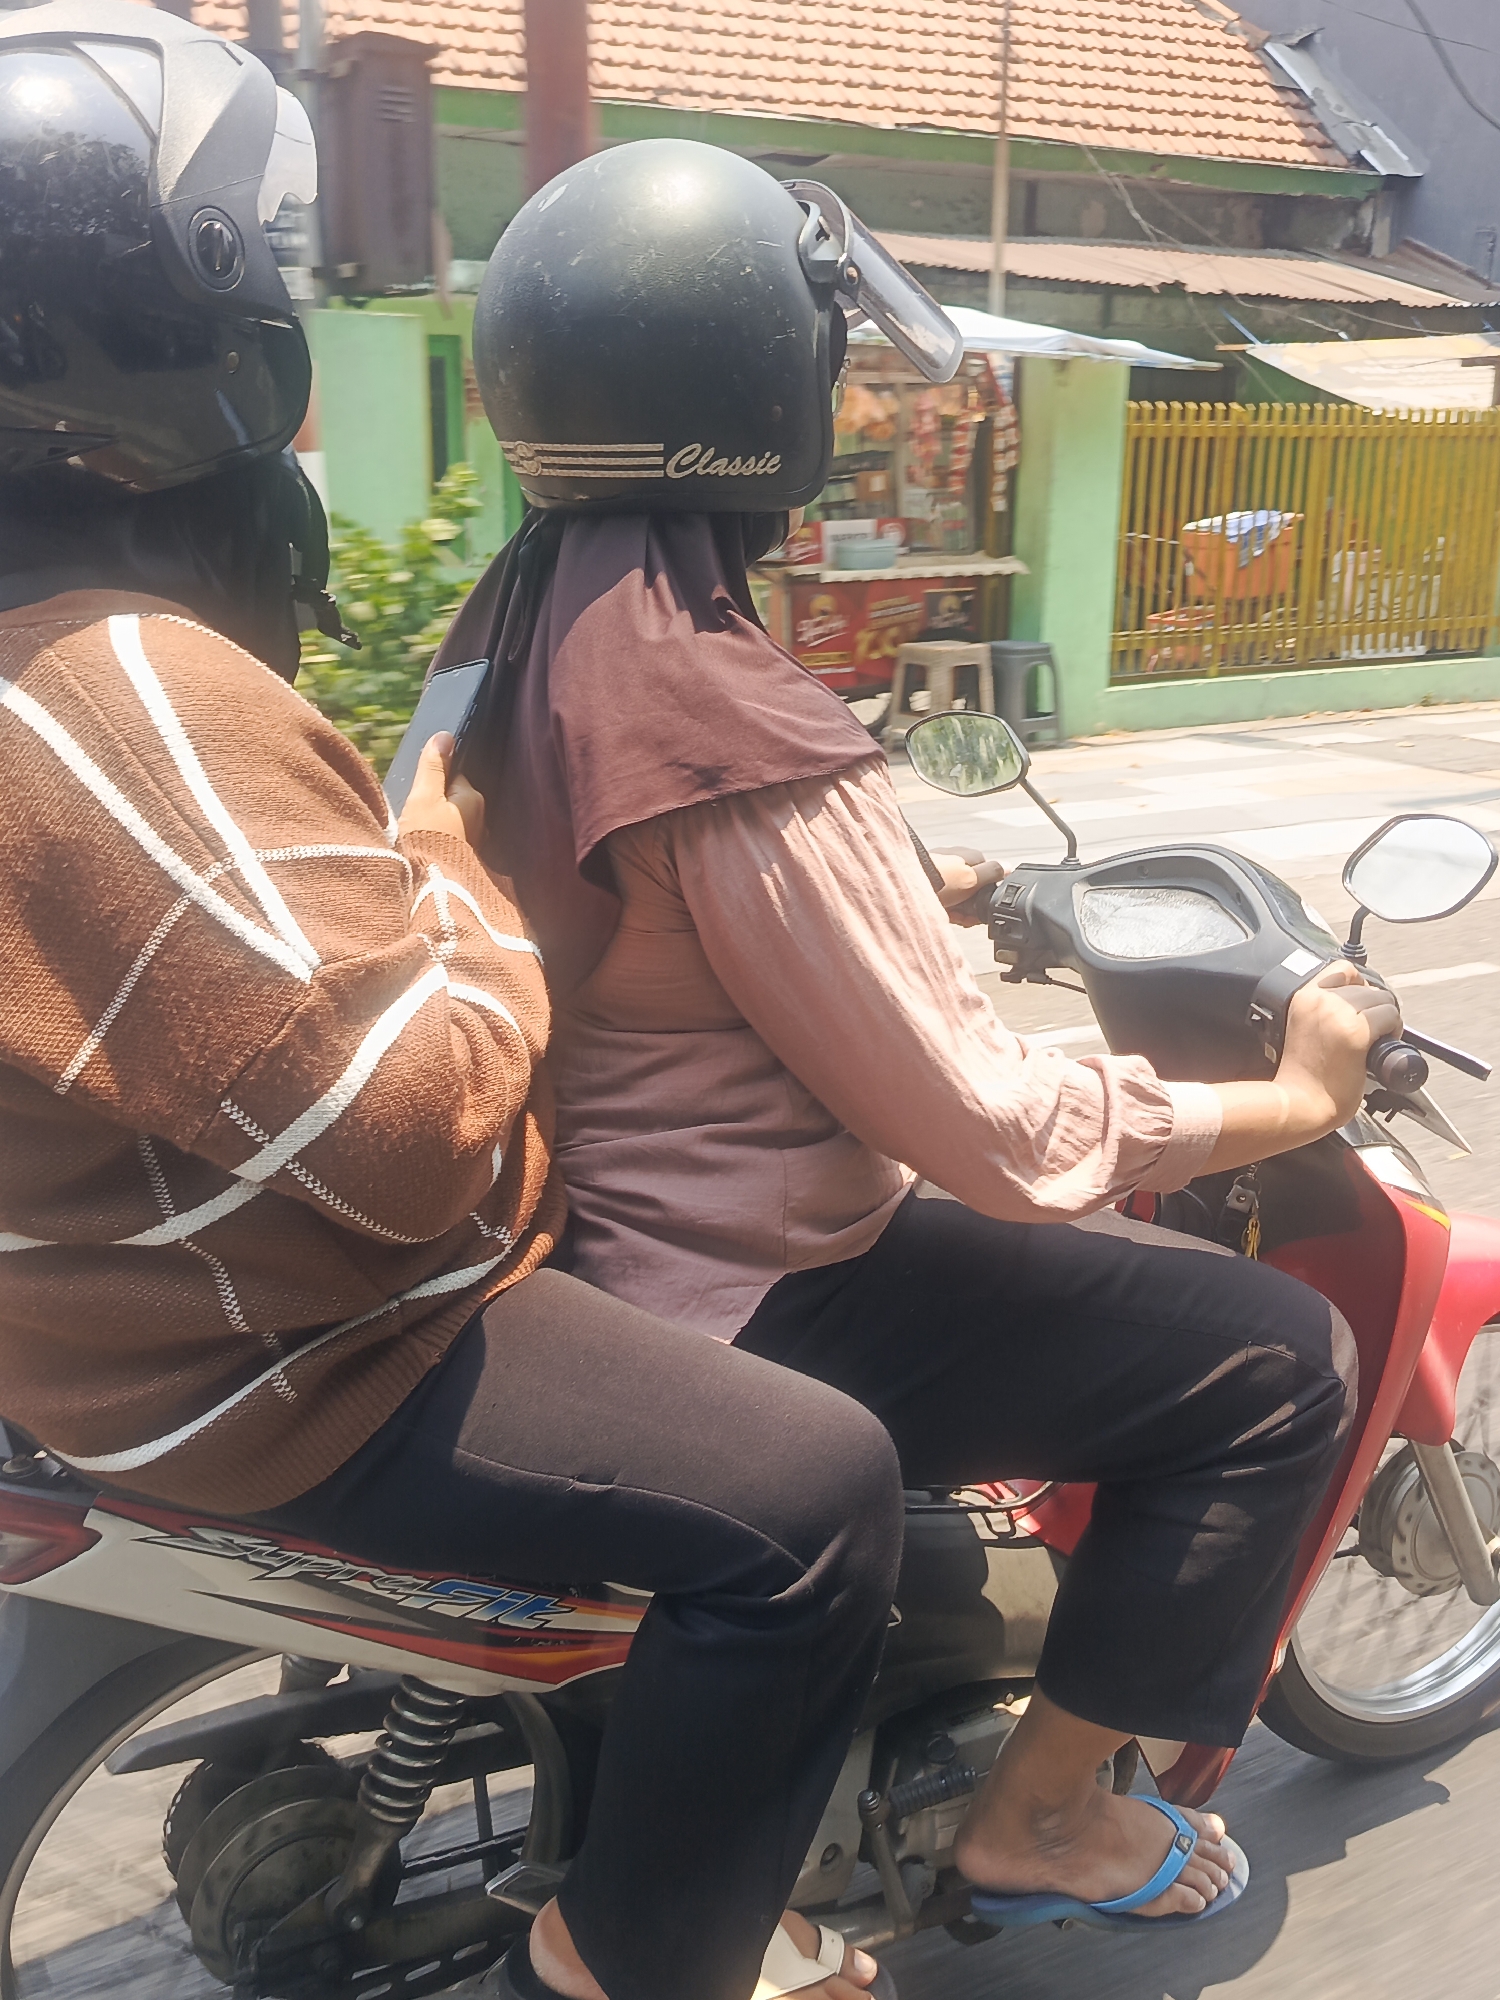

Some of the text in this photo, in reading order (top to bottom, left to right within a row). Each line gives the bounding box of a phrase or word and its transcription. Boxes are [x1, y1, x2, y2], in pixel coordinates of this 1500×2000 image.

[666, 443, 781, 479] Classic
[131, 1526, 576, 1630] Supra Fit
